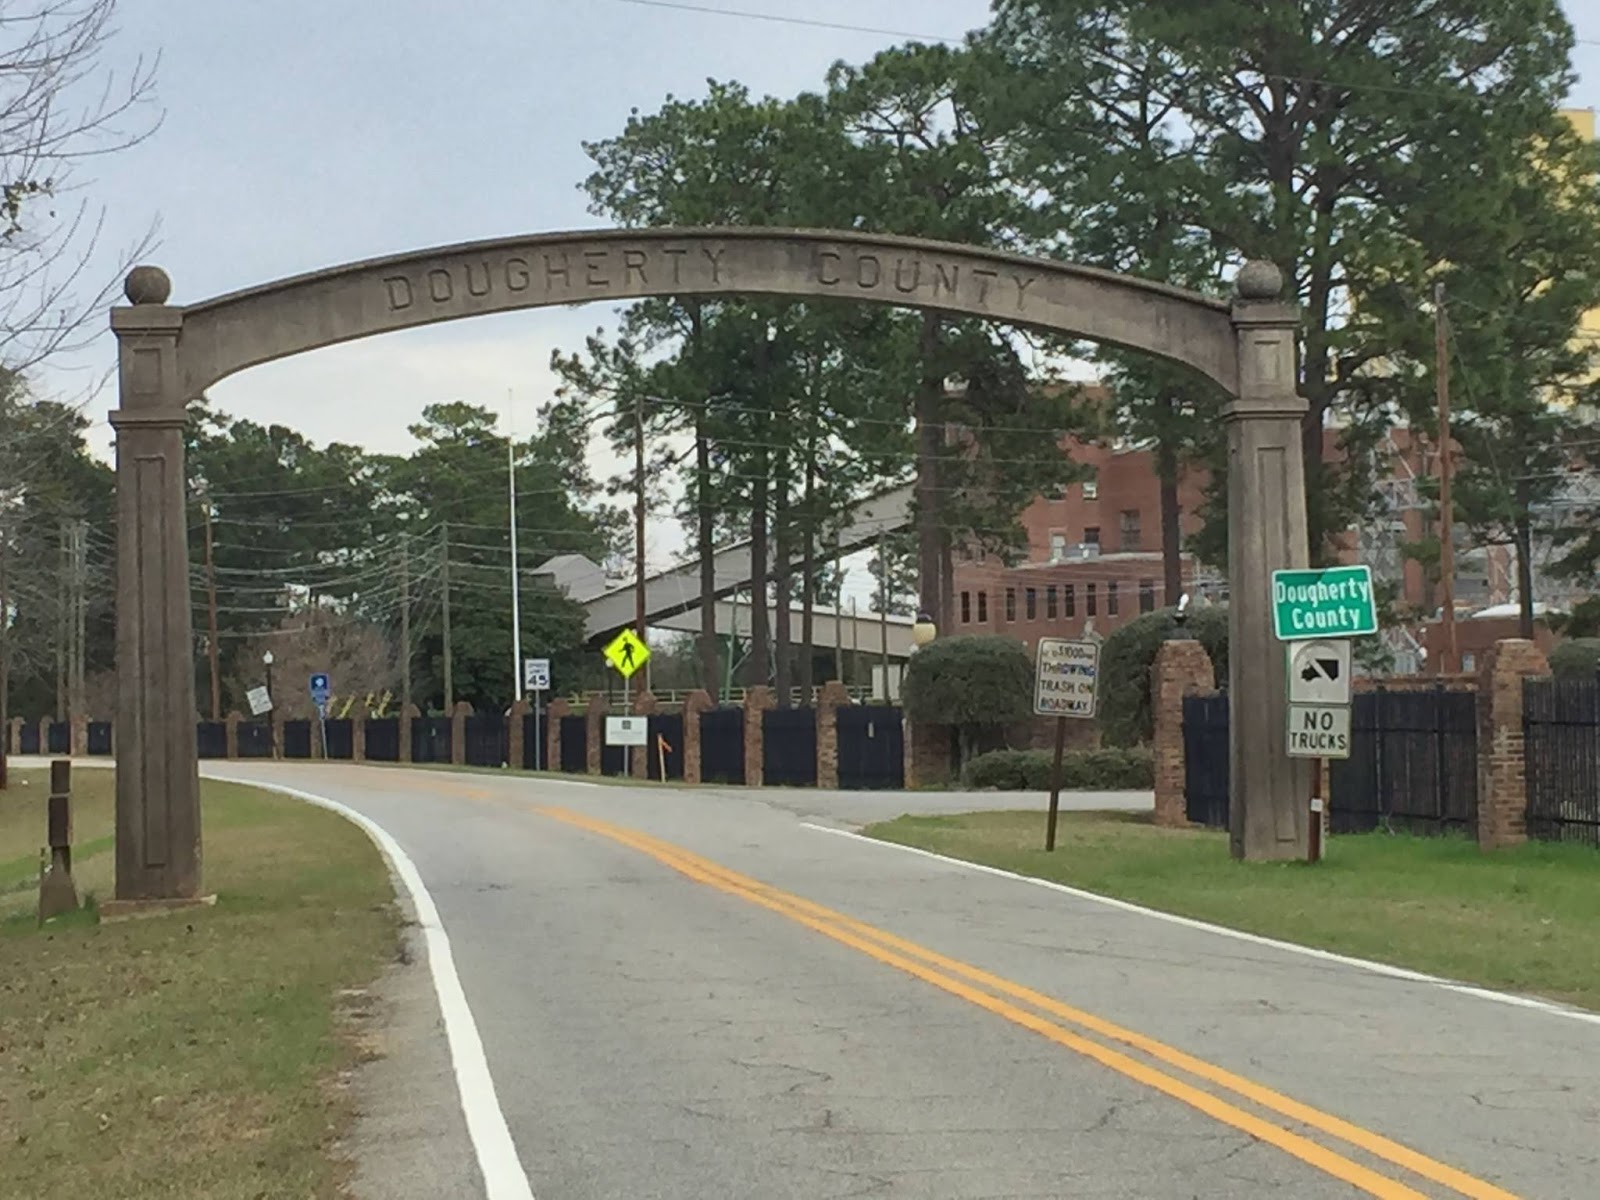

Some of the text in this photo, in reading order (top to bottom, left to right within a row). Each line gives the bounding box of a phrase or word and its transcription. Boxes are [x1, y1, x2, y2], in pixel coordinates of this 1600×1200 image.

[382, 248, 1037, 311] DOUGHERTY COUNTY
[1276, 578, 1368, 607] Dougherty
[1292, 607, 1360, 629] County
[527, 675, 548, 686] 45
[1041, 679, 1075, 693] TRASH
[1304, 711, 1333, 730] NO
[1291, 732, 1347, 749] TRUCKS
